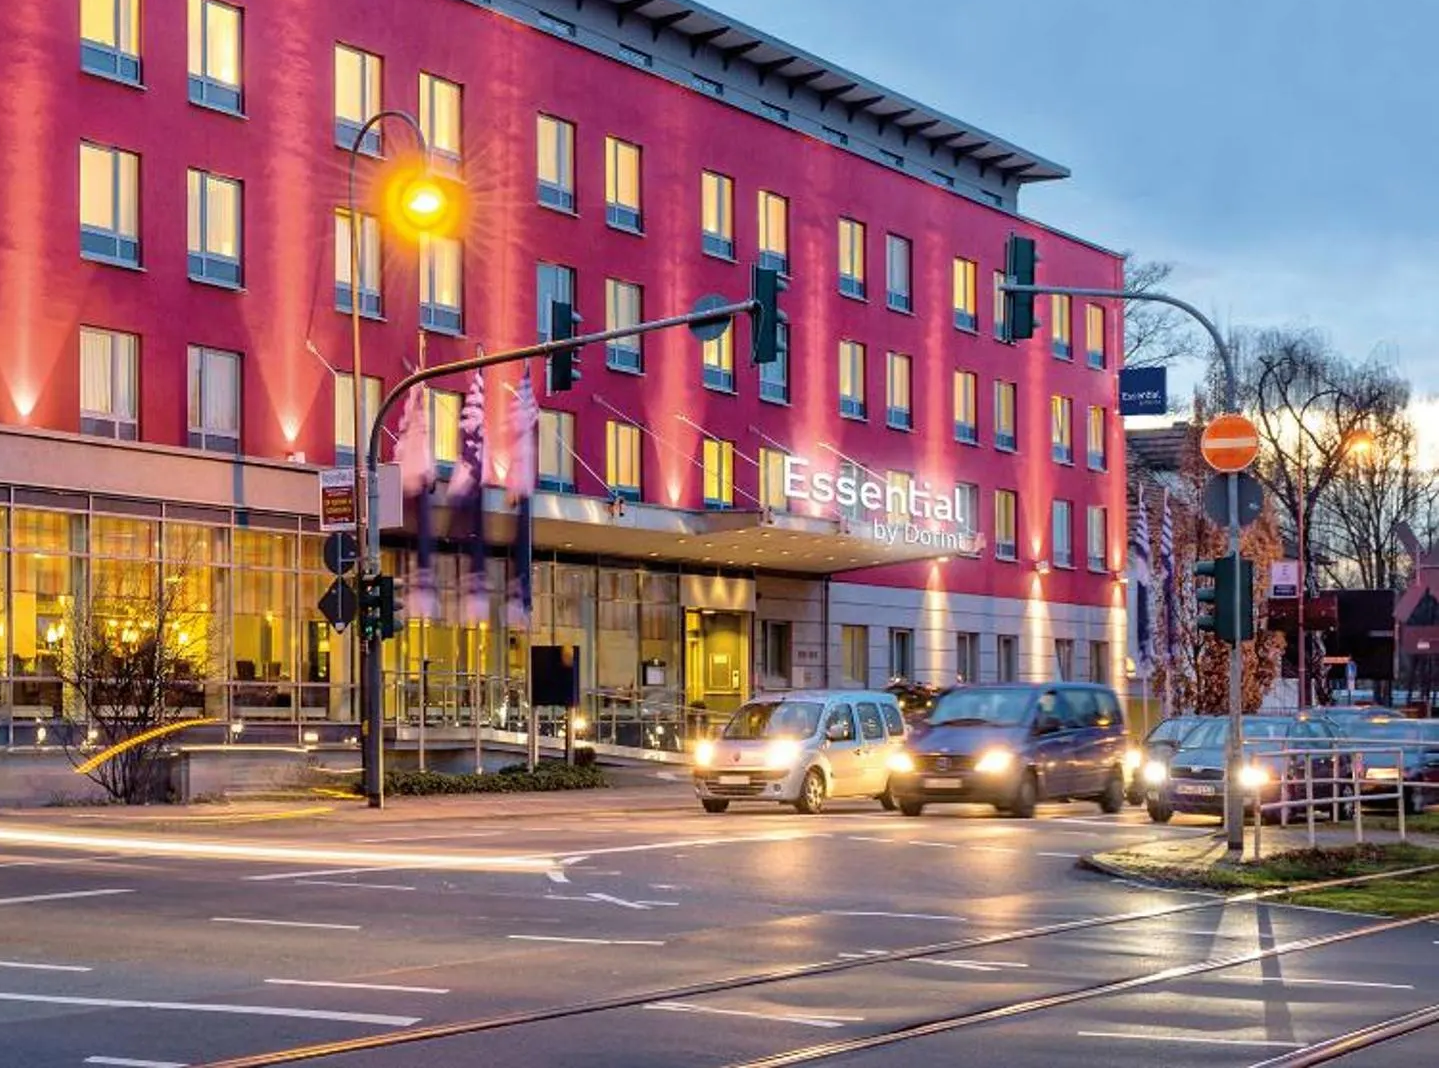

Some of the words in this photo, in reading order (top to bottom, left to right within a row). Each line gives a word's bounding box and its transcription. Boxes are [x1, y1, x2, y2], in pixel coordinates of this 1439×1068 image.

[784, 455, 964, 521] Essential
[873, 518, 897, 545] by
[904, 522, 967, 549] Dorint
